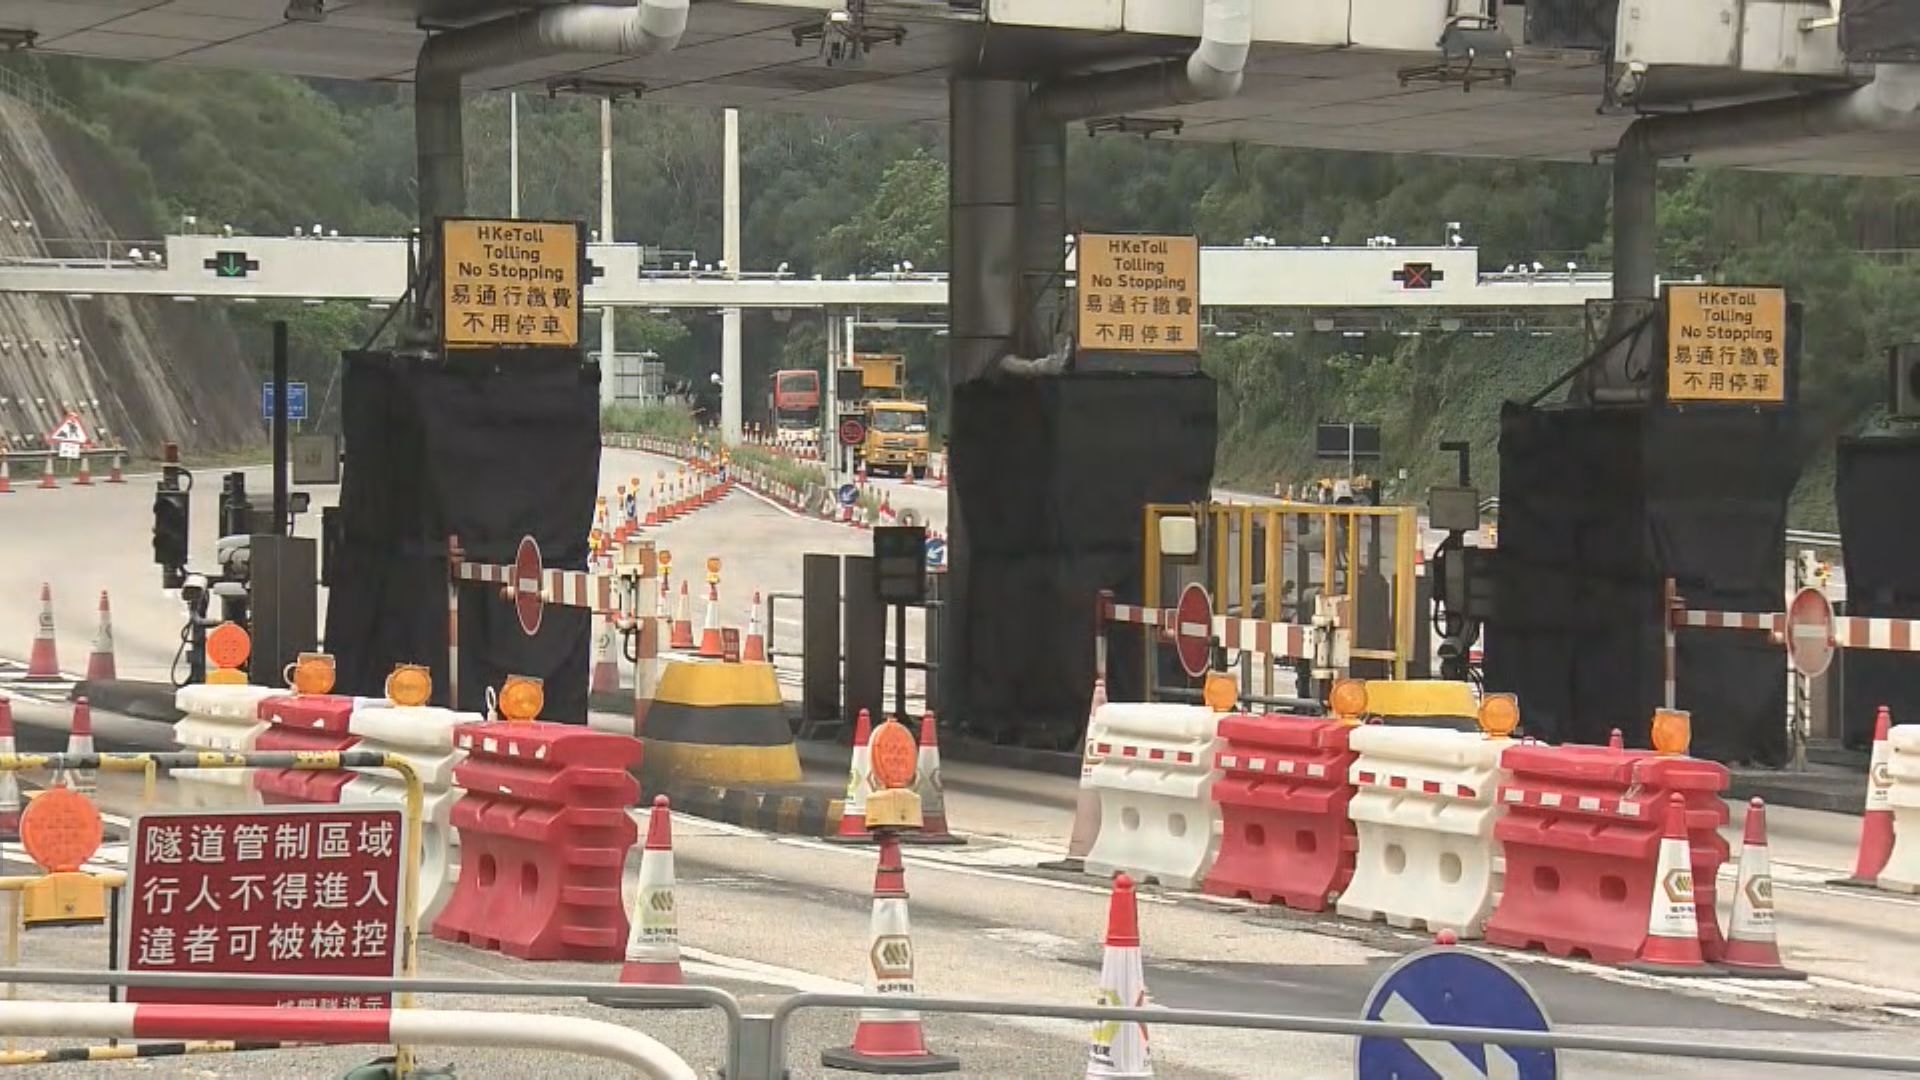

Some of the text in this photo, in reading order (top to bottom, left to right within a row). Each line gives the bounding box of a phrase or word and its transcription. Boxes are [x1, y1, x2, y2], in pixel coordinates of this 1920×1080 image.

[478, 226, 544, 242] HKeToll
[483, 244, 540, 262] Tolling
[1108, 240, 1168, 255] HKeToll
[458, 262, 564, 282] No Stopping
[1113, 258, 1164, 274] Tolling
[1091, 274, 1186, 291] No Stopping
[451, 284, 572, 308] 易通行繳費
[1085, 294, 1192, 315] 易通行繳費
[1698, 292, 1756, 305] HKeToll
[463, 312, 562, 336] 不用停車
[1703, 308, 1752, 325] Tolling
[1096, 323, 1183, 343] 不用停車
[1681, 325, 1772, 342] No Stopping
[1674, 344, 1779, 367] 易通行繳費
[1683, 372, 1769, 392] 不用停車
[145, 820, 394, 865] 隧道管制區域
[143, 870, 389, 914] 行人不得進入
[137, 919, 389, 966] 違者可被檢控
